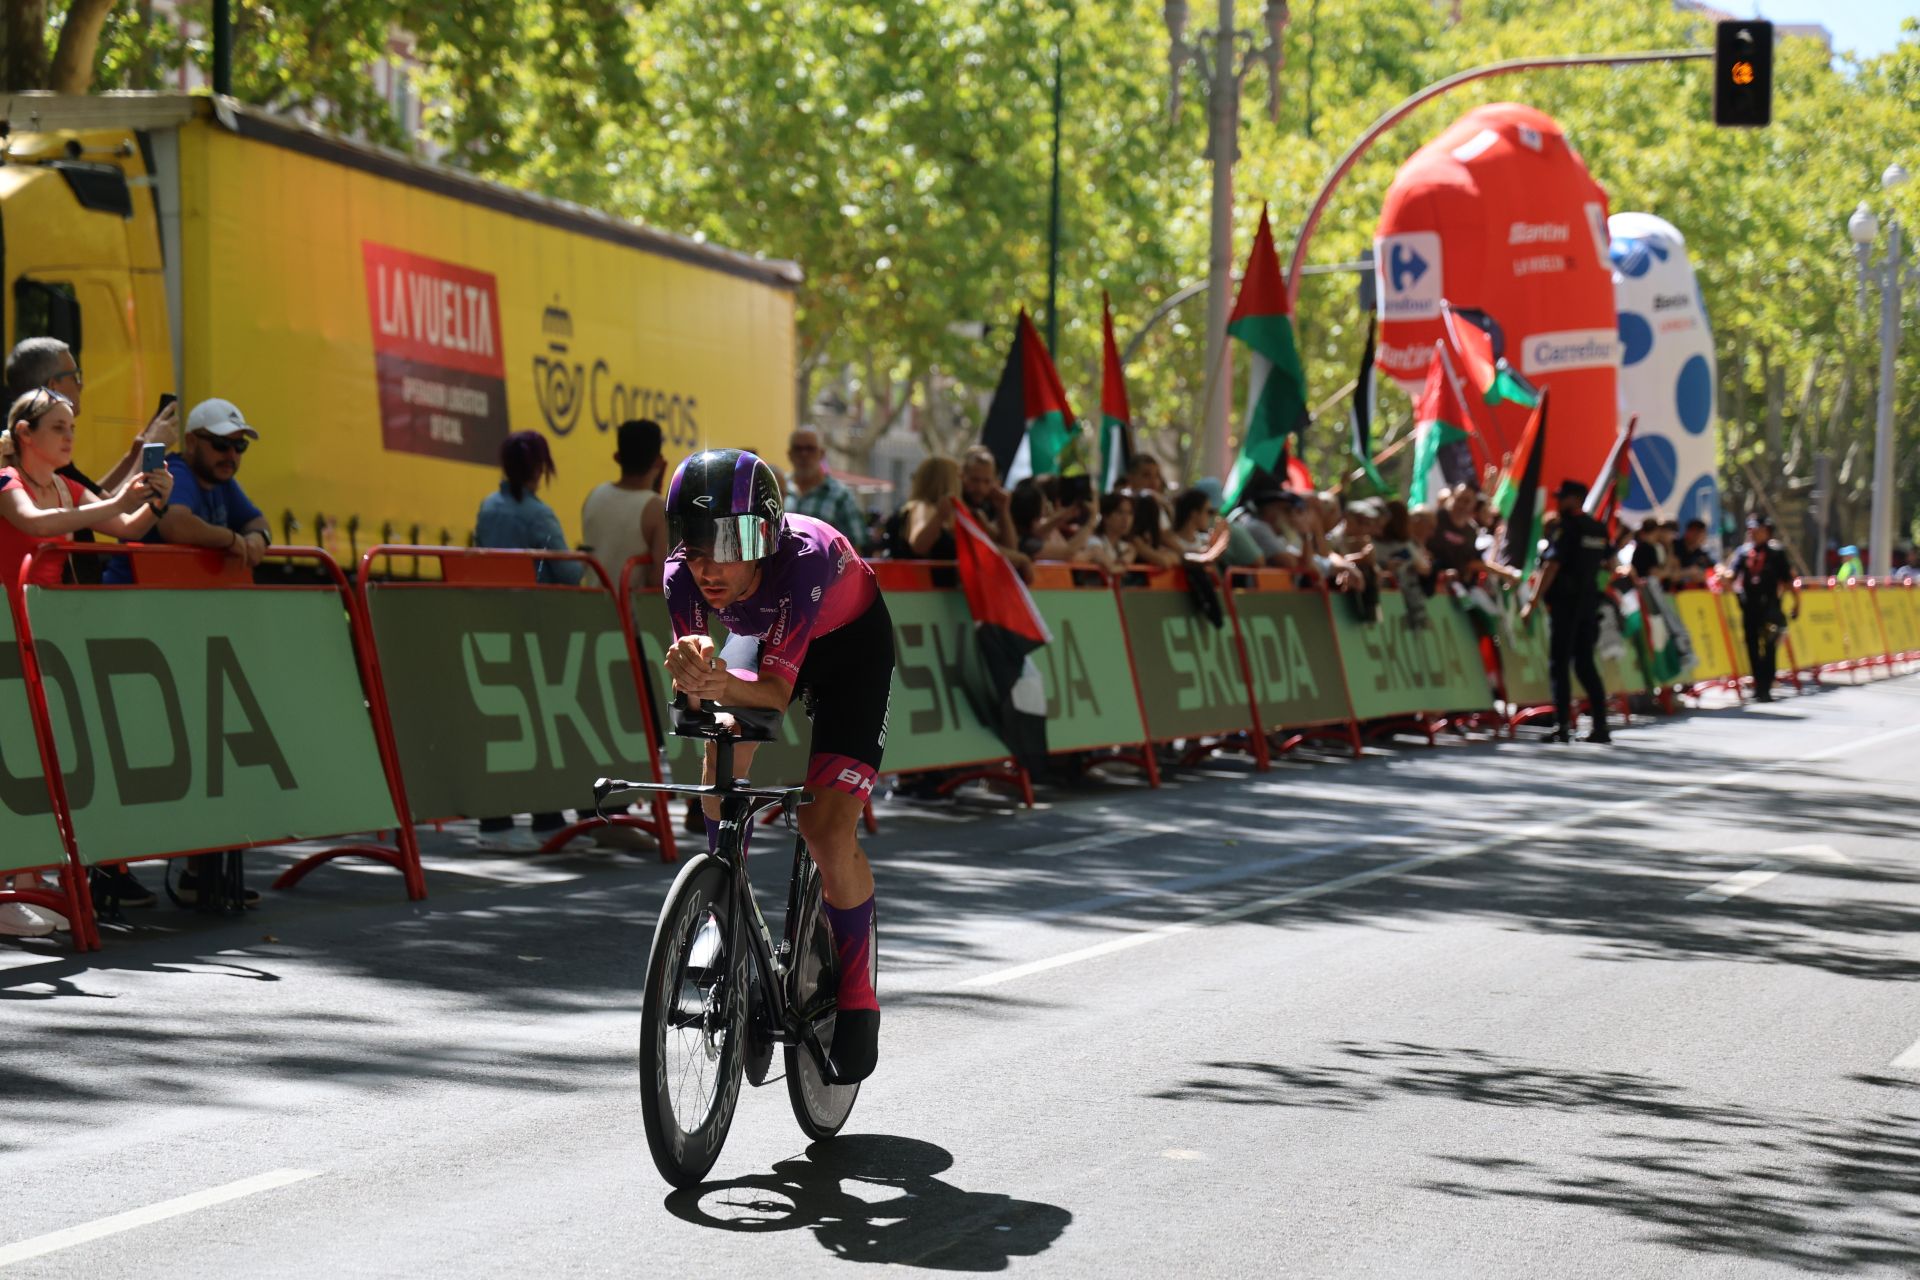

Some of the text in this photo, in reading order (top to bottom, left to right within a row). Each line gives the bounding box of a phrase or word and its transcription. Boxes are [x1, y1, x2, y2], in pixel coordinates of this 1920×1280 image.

[377, 263, 494, 358] LA VUELTA
[591, 358, 699, 448] Correos
[837, 768, 874, 796] BH
[718, 819, 740, 831] BH
